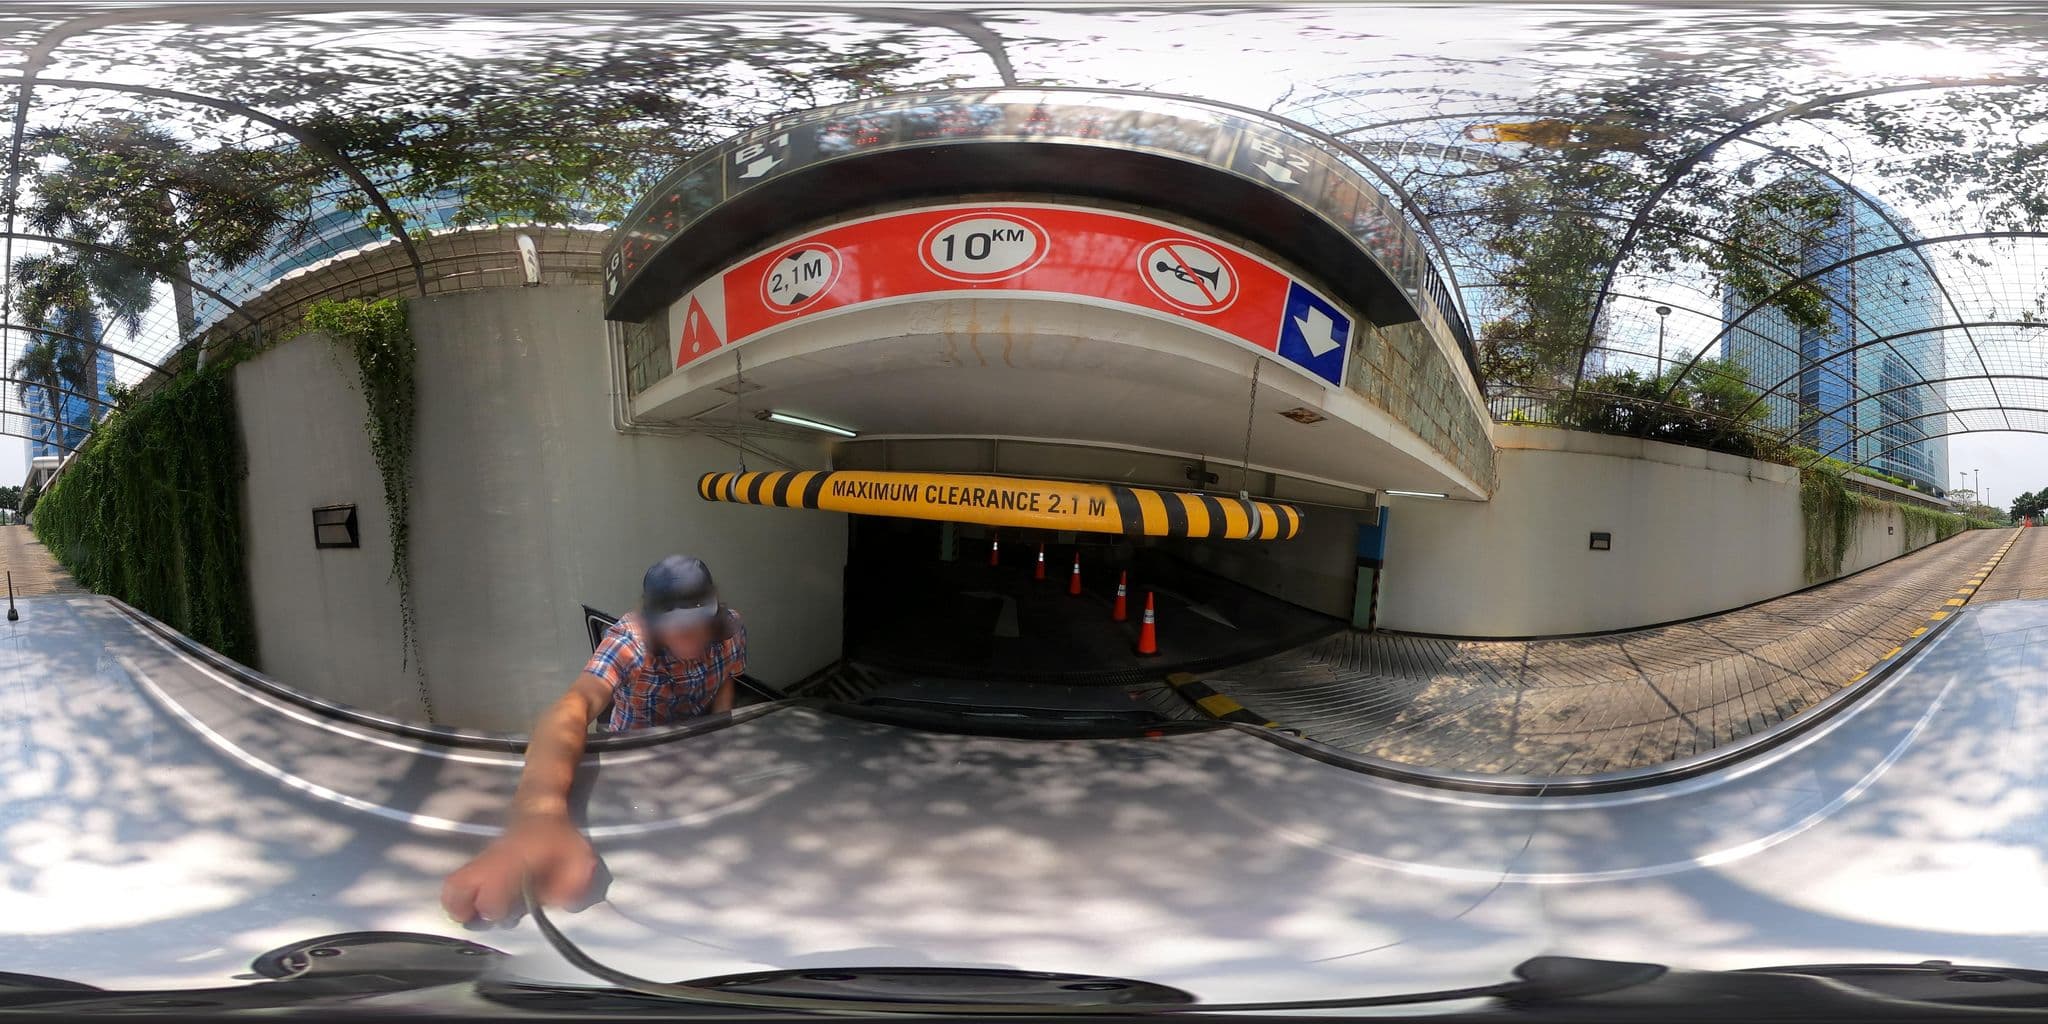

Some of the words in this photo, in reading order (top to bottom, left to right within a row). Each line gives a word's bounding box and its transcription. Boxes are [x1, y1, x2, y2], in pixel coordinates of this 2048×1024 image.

[735, 133, 790, 165] B1
[1251, 139, 1310, 173] B2
[606, 252, 620, 280] LG
[832, 480, 918, 502] MAXIMUM
[925, 485, 1040, 512] CLEARANCE
[1047, 493, 1079, 514] 2.1
[1088, 497, 1106, 516] M
